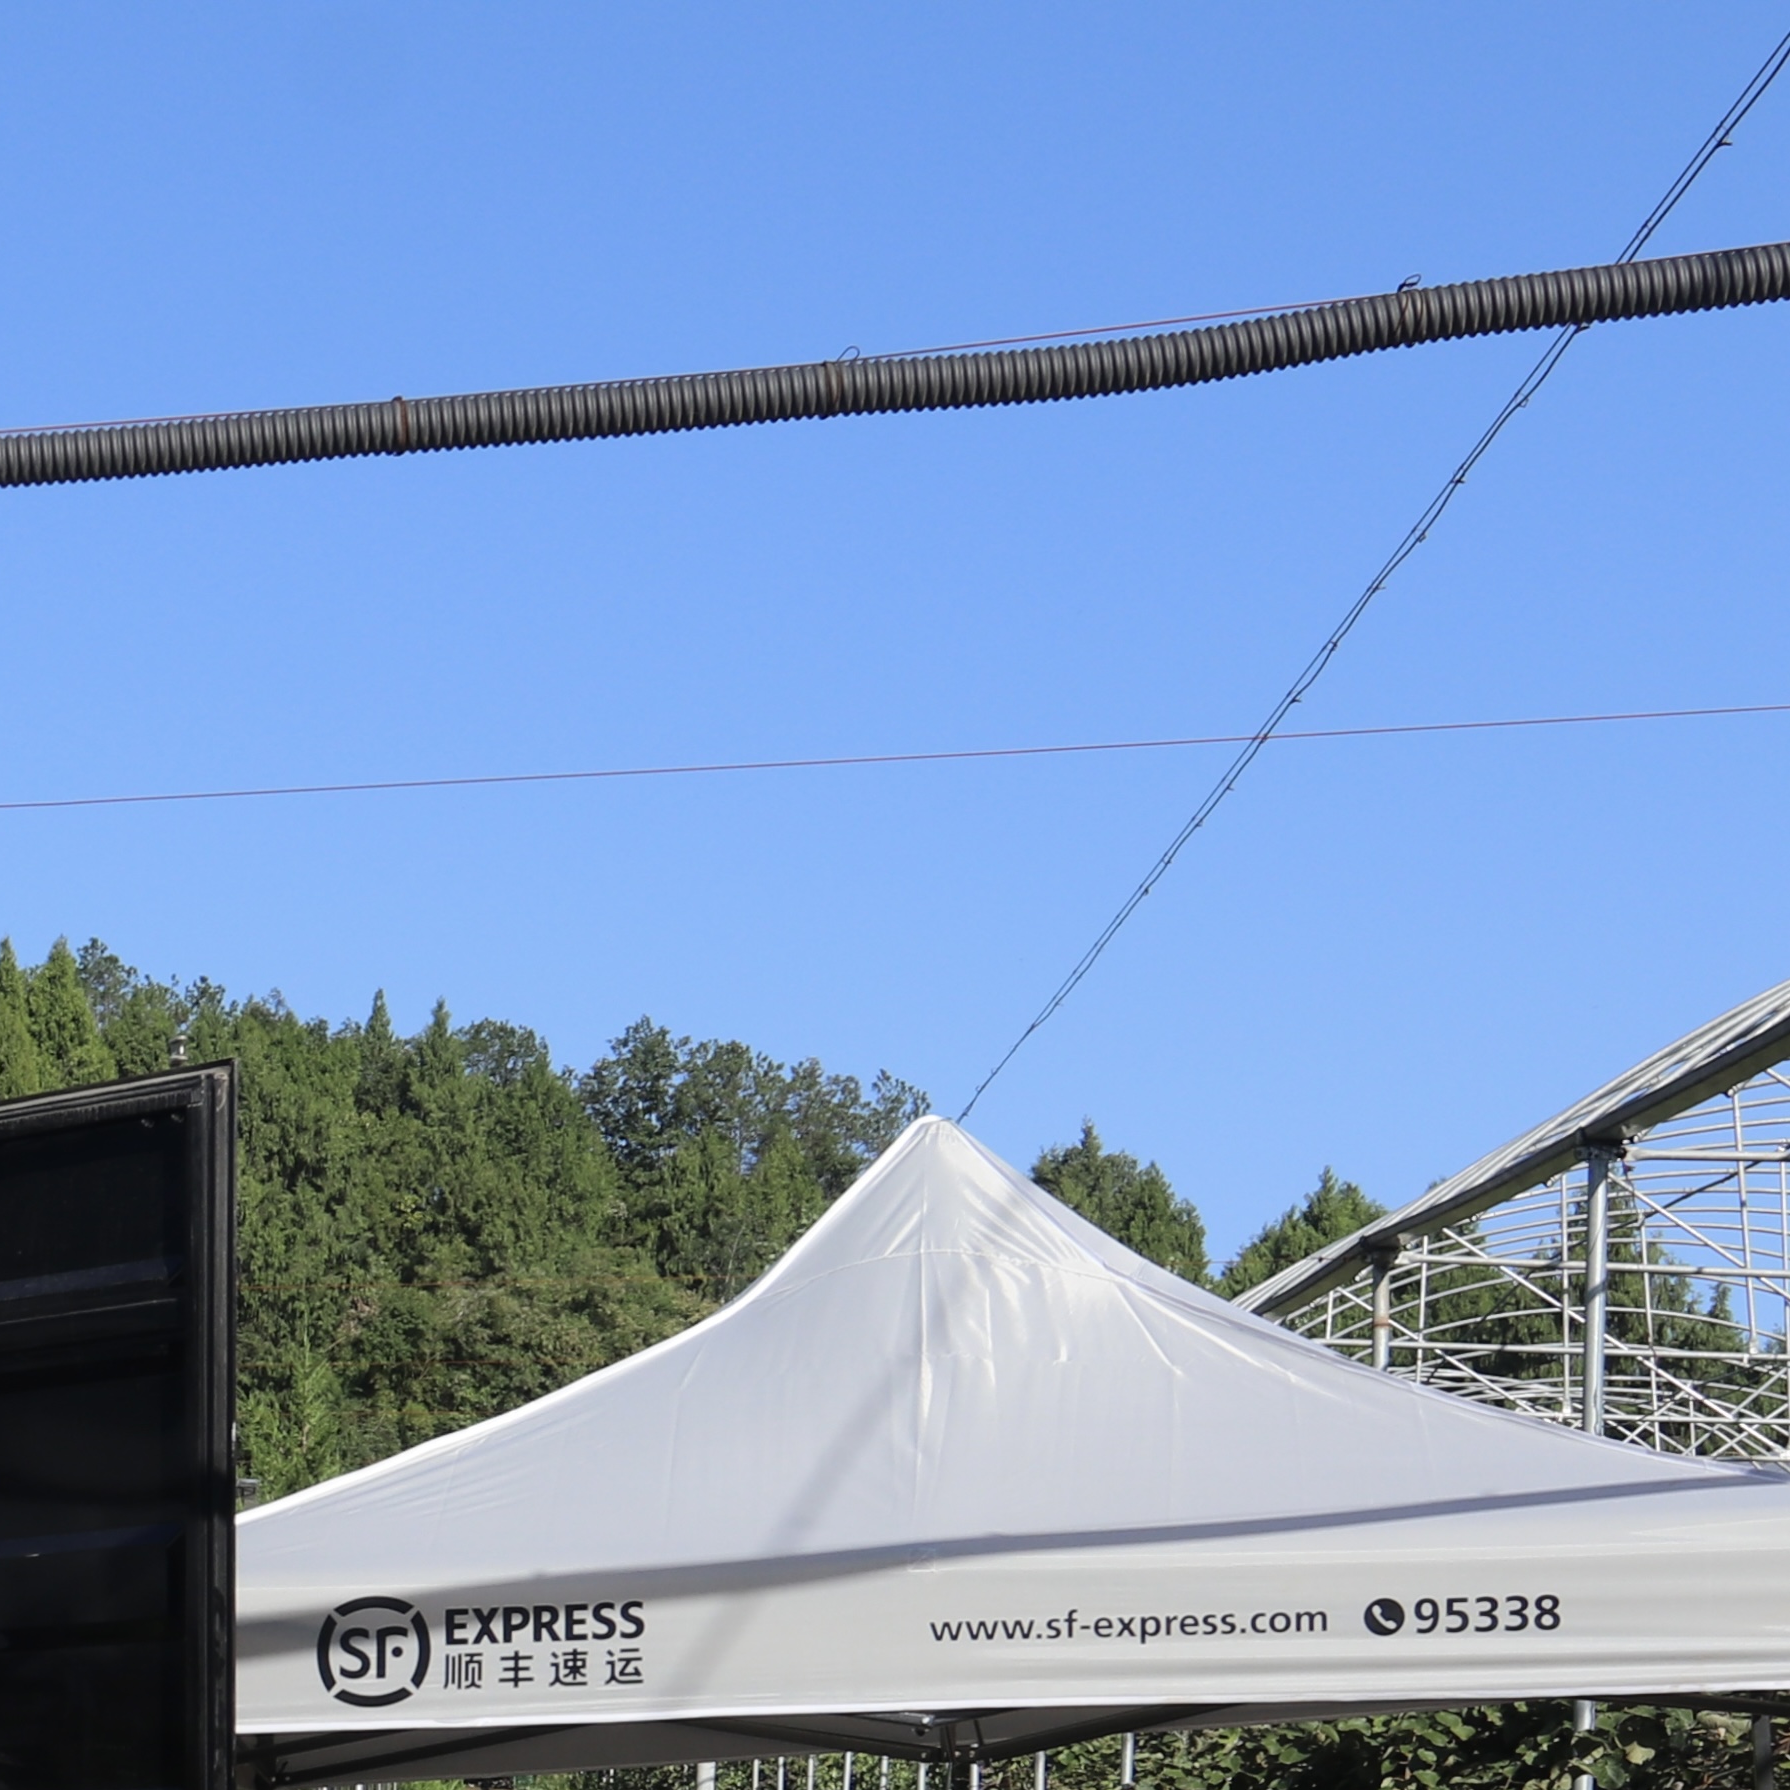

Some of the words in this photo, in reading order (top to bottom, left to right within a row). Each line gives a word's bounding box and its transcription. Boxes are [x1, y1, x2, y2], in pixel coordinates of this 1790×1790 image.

[444, 1601, 645, 1645] EXPRESS
[929, 1609, 1328, 1644] www.sf-express.com
[1414, 1594, 1561, 1634] 95338
[443, 1648, 644, 1690] 顺丰速运
